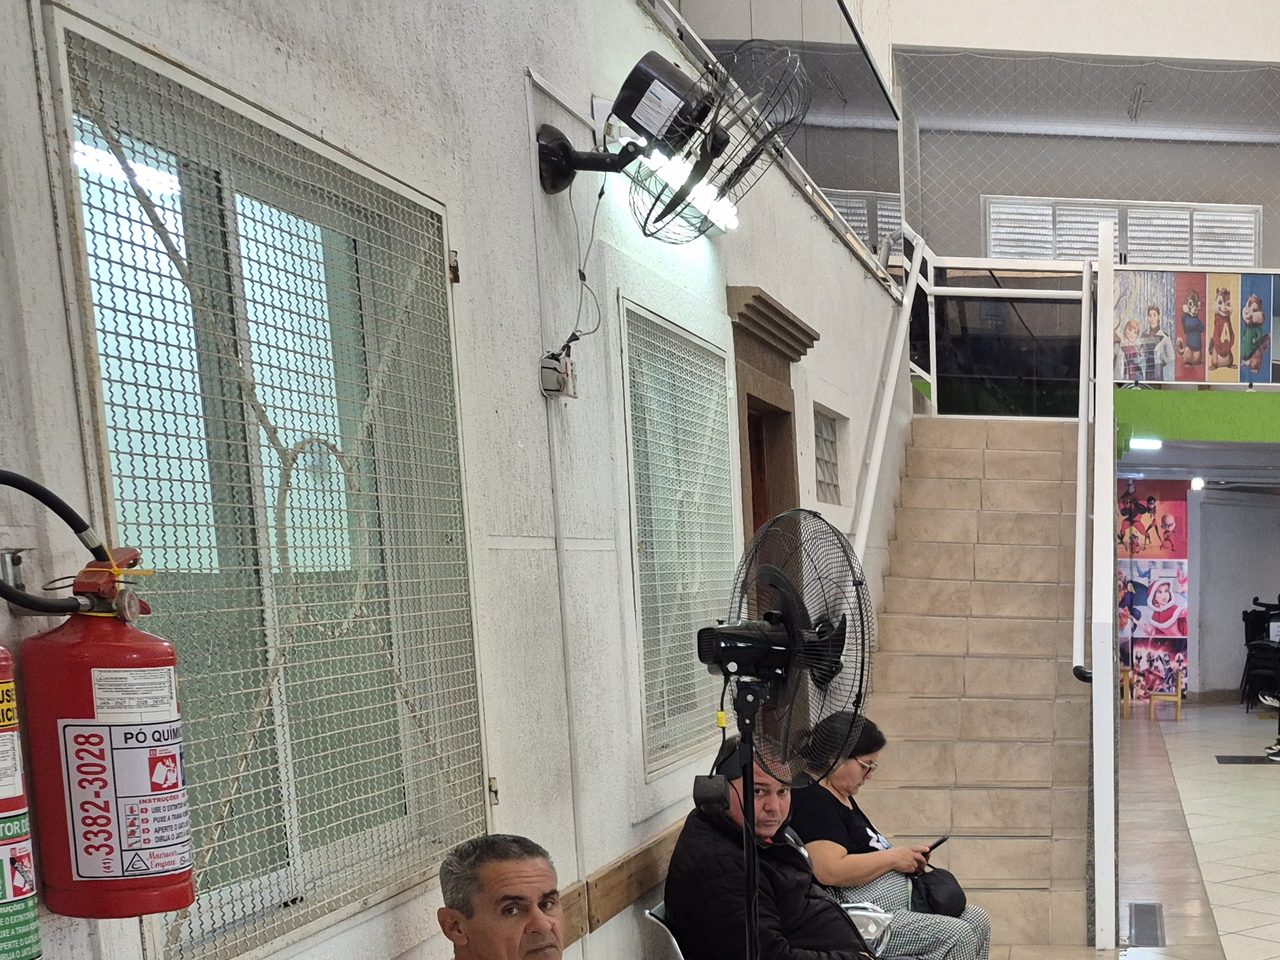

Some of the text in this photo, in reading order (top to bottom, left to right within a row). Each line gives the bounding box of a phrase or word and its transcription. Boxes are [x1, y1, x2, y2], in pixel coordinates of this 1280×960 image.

[124, 728, 147, 744] PÓ
[73, 733, 115, 873] (41) 3382-3028
